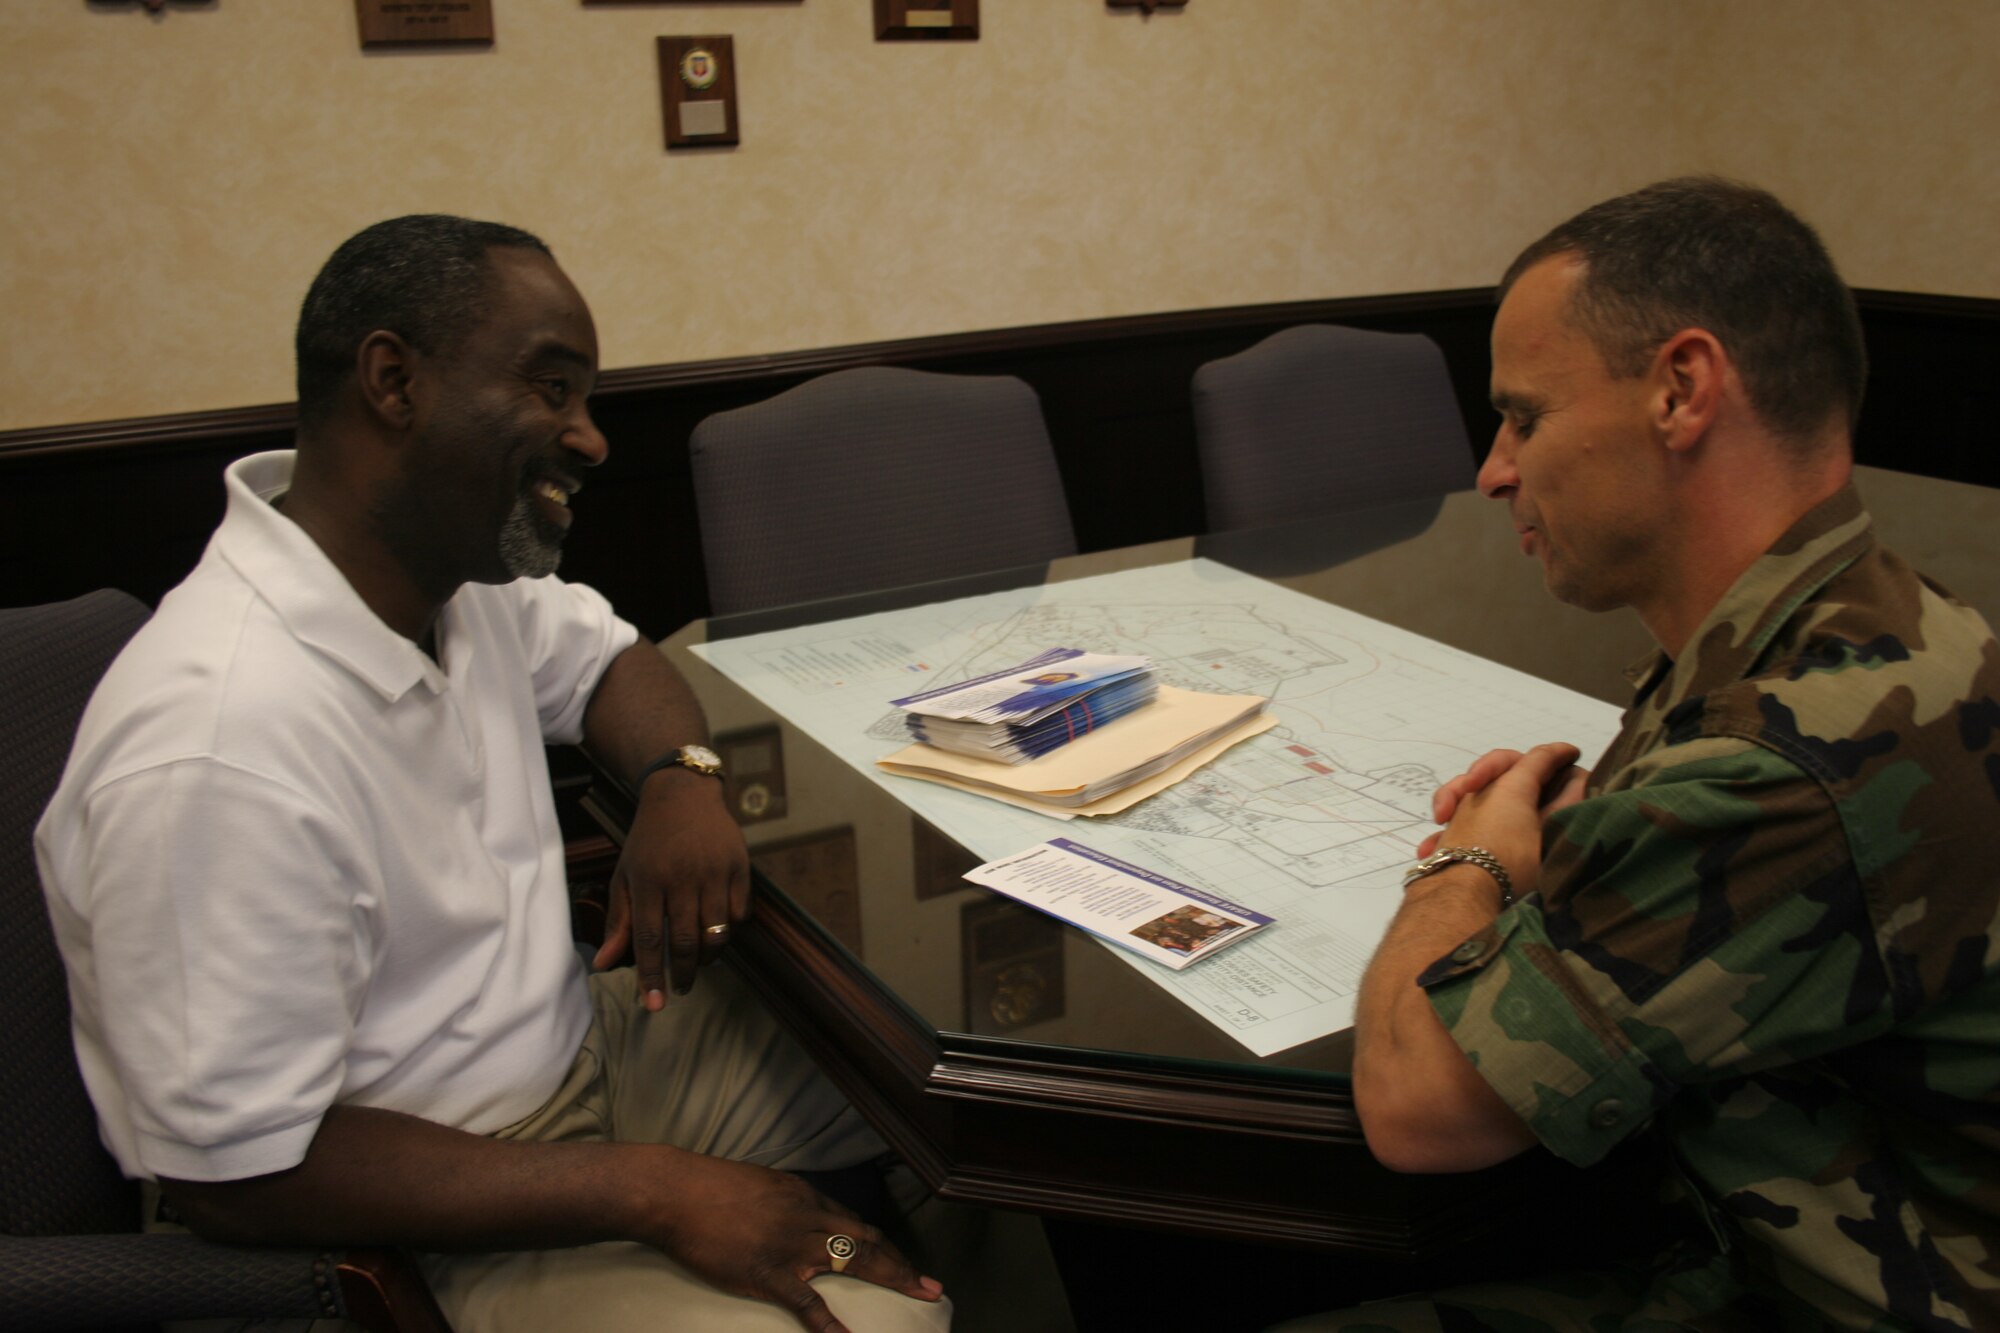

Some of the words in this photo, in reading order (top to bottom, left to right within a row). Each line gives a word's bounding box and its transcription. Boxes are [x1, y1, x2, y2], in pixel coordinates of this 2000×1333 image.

[1068, 844, 1107, 862] Education
[1162, 879, 1182, 890] Plan
[1182, 887, 1222, 905] Strategic
[1218, 902, 1253, 916] USAFE
[1230, 974, 1267, 997] DISTANCE
[1247, 976, 1278, 994] SAFETY
